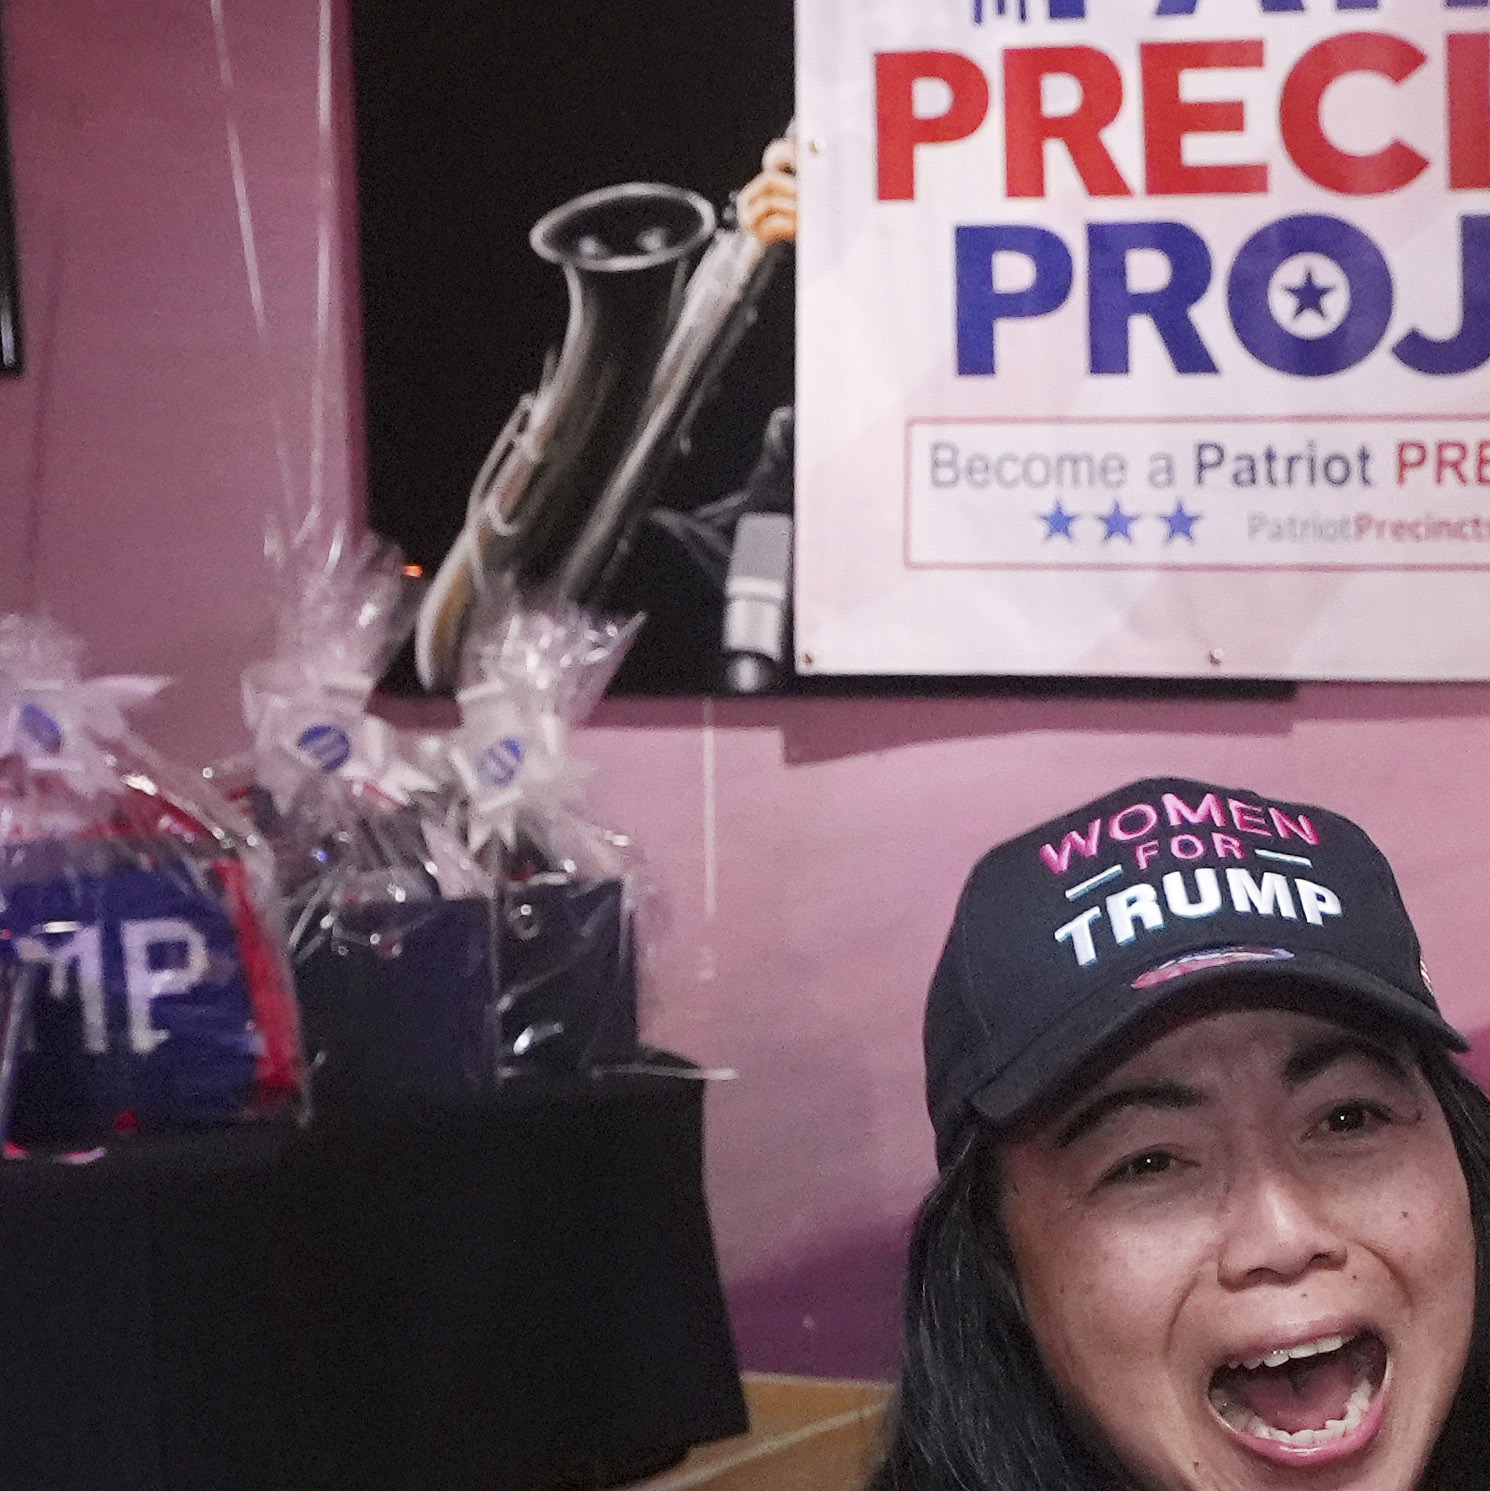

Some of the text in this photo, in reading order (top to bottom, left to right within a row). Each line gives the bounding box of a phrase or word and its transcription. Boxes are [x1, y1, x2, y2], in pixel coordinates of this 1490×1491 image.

[928, 440, 1129, 489] Become
[1147, 451, 1177, 489] a
[1194, 440, 1372, 489] Patriot
[1041, 793, 1321, 874] WOMEN
[1135, 832, 1247, 870] FOR
[1054, 868, 1343, 966] TRUMP
